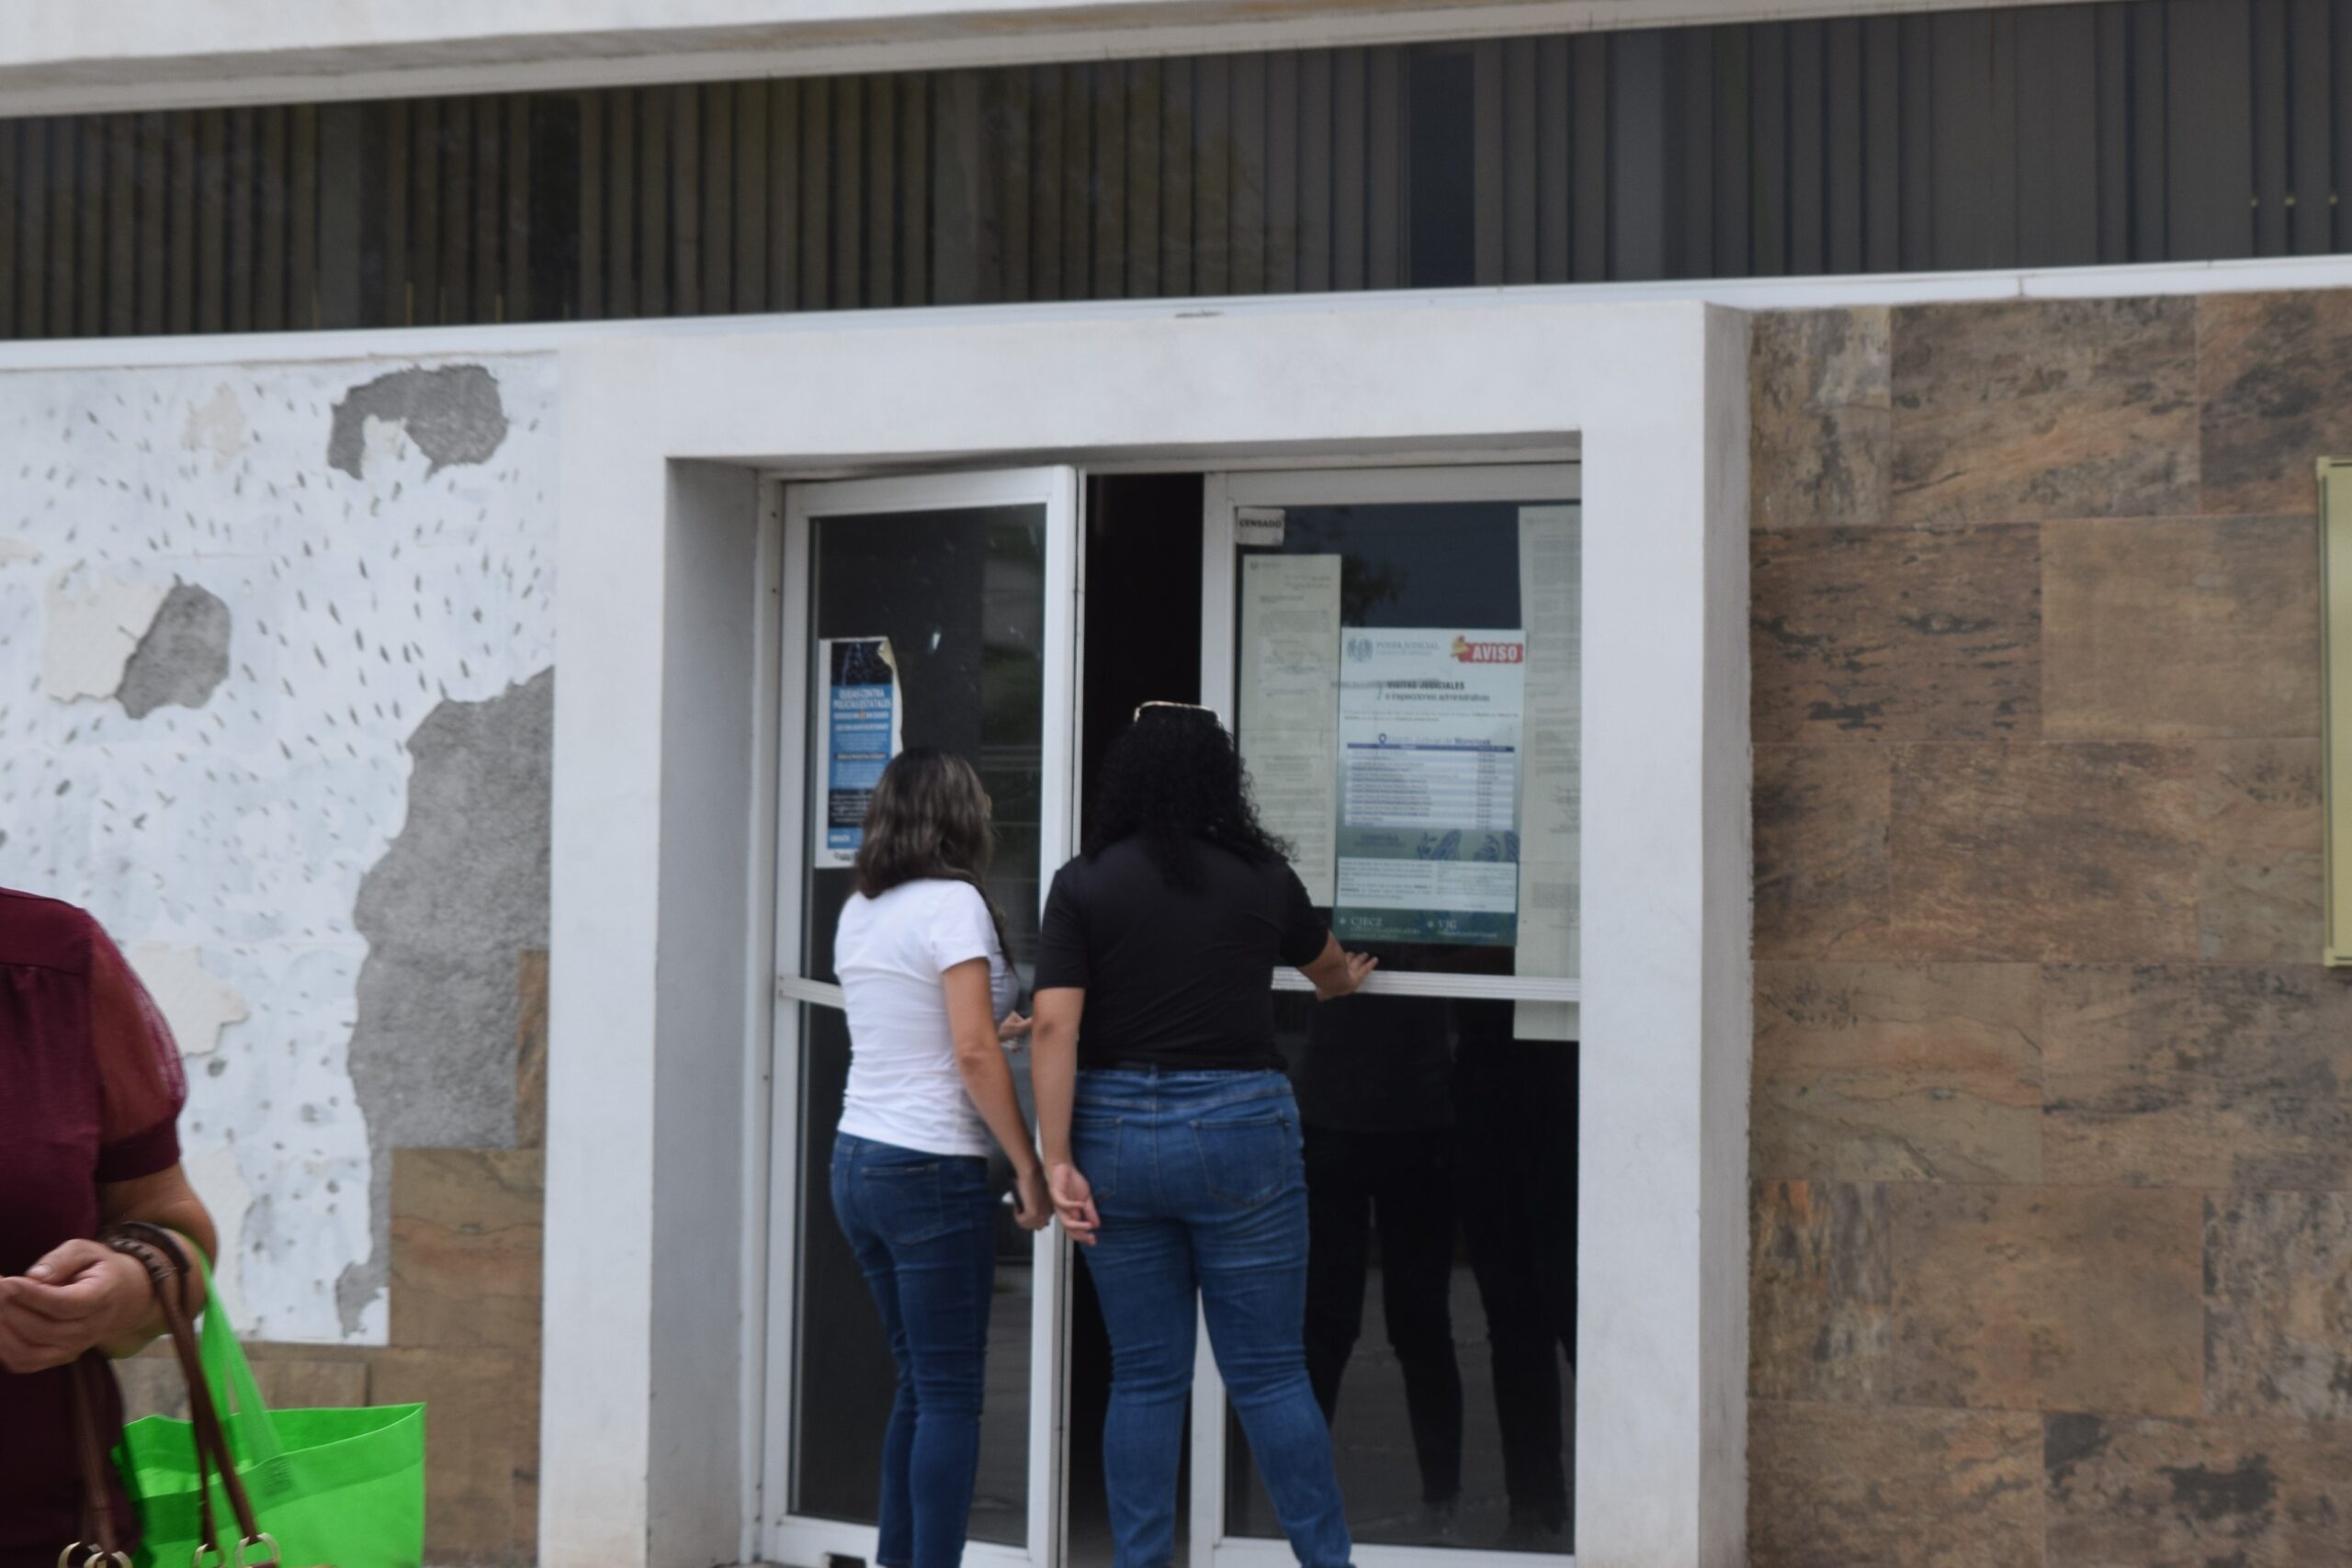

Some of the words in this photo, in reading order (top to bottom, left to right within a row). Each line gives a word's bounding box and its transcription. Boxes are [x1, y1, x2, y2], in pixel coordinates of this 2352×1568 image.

[1239, 518, 1282, 528] CENSADO
[1472, 645, 1518, 660] AVISO
[1419, 681, 1465, 690] JUDICIALES
